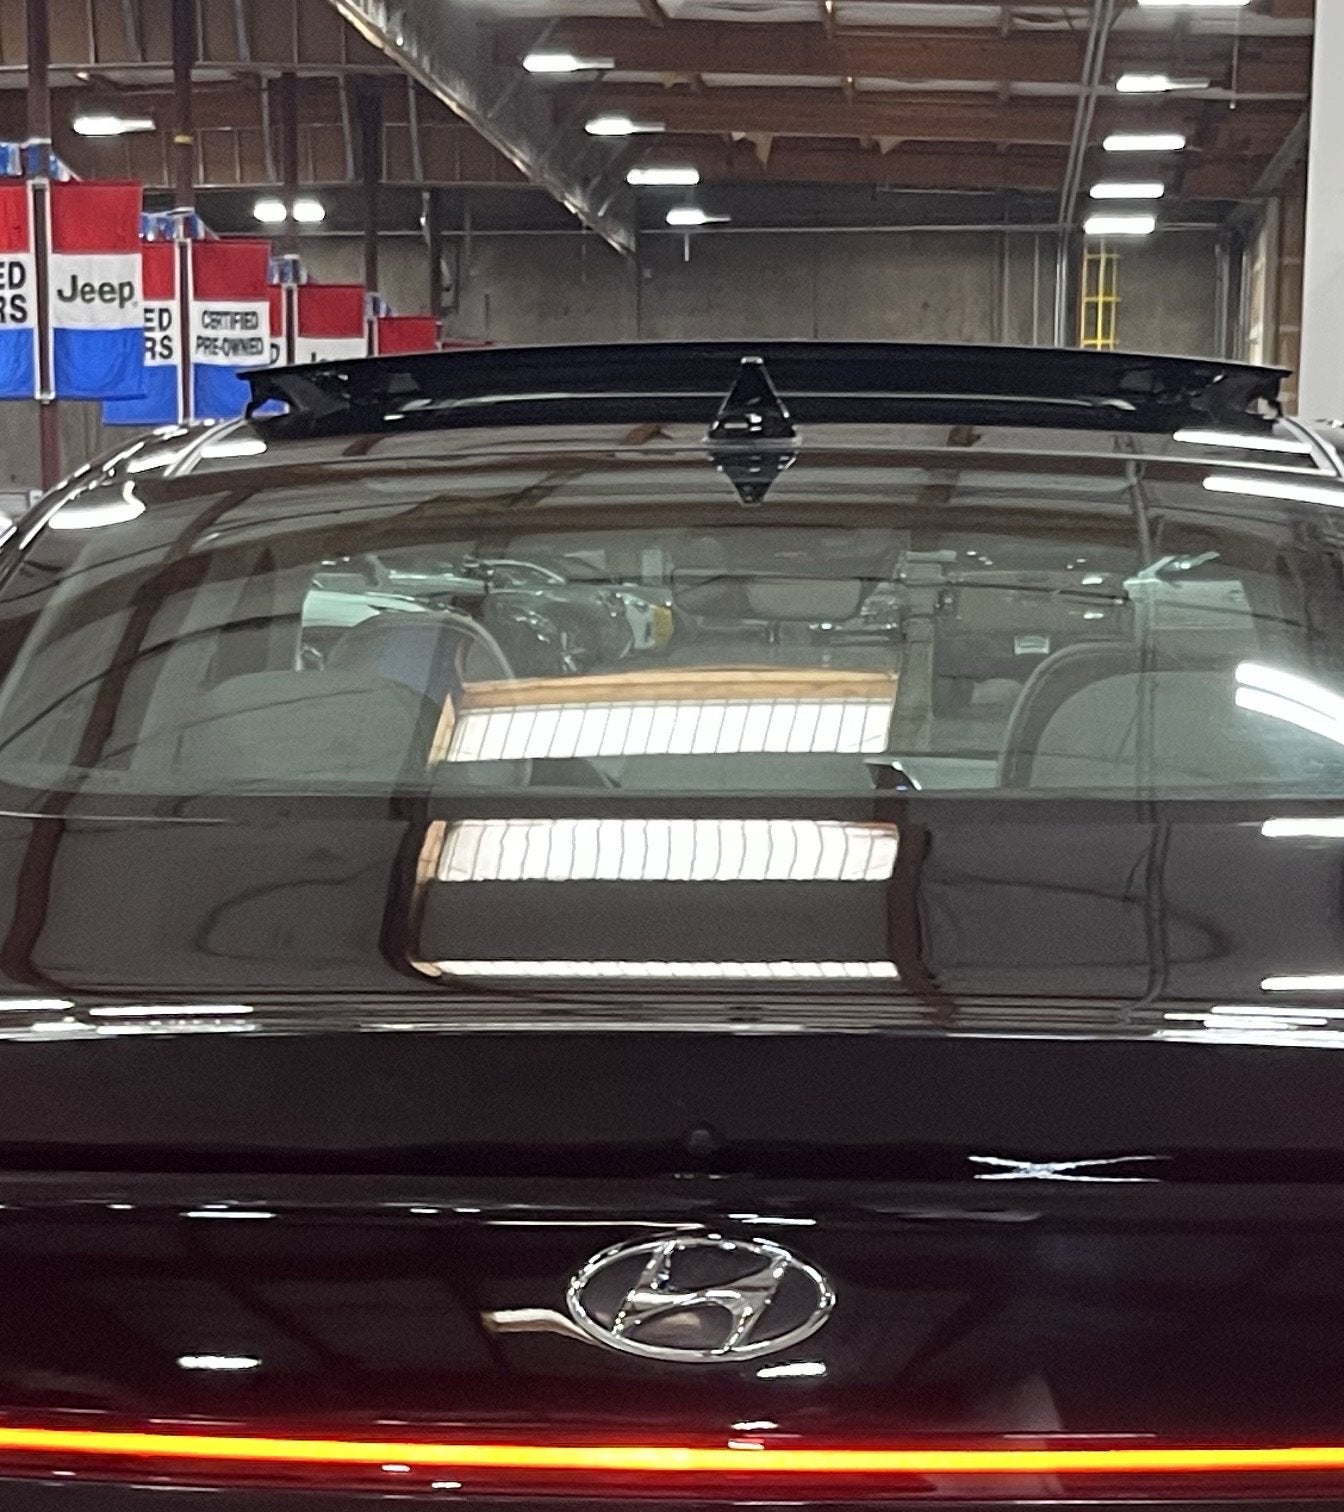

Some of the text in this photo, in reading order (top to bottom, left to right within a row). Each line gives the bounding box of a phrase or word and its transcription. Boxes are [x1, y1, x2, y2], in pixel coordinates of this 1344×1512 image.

[57, 274, 135, 309] Jeep
[202, 310, 259, 331] CERTIFIED
[196, 336, 264, 357] PRE-OWNED
